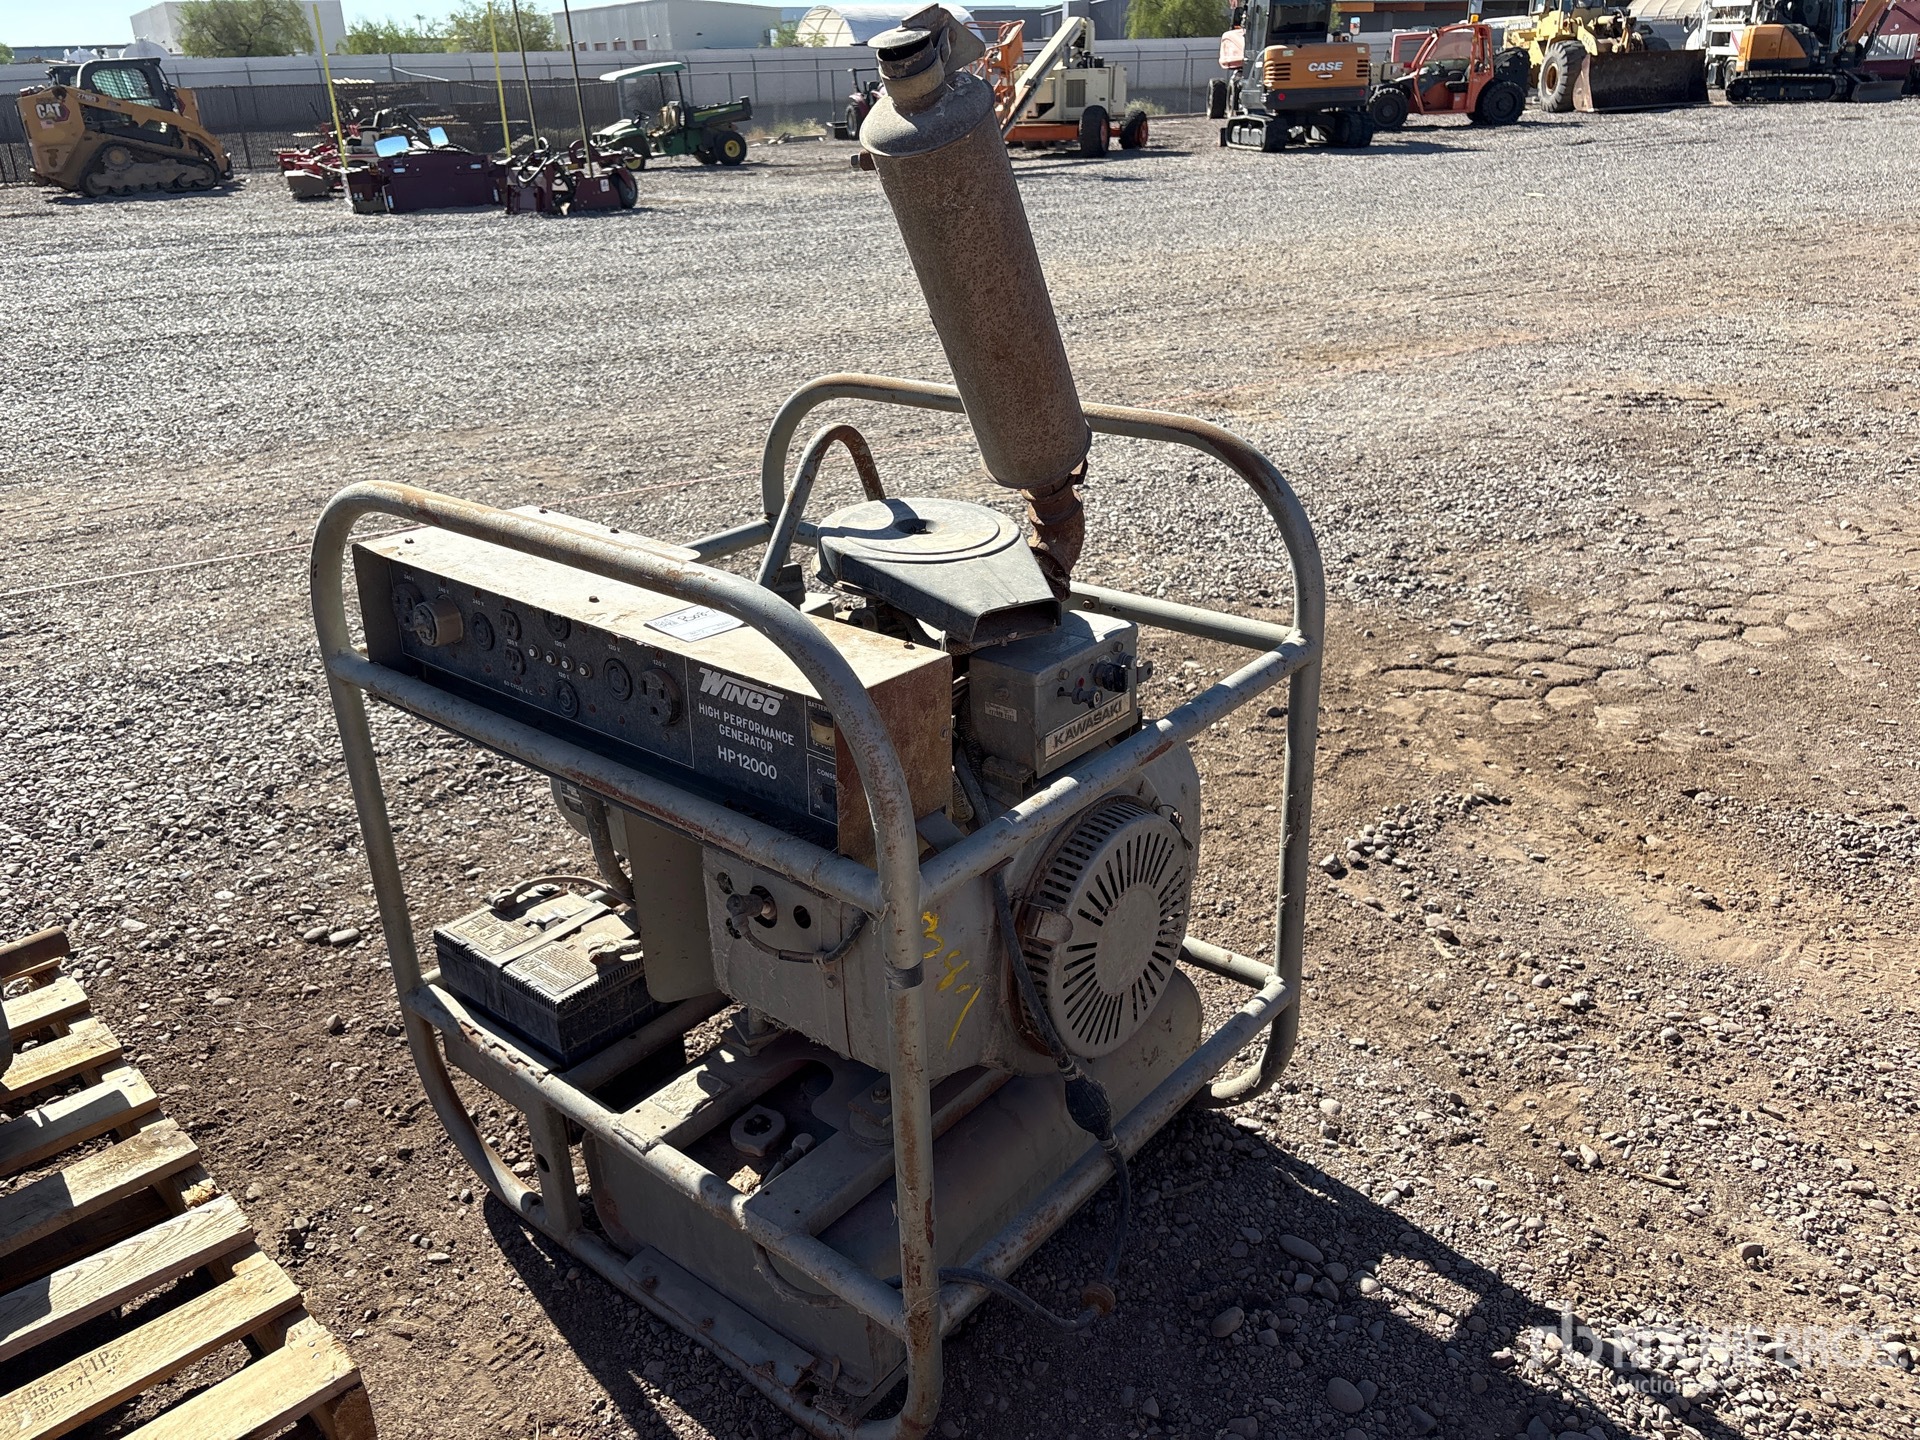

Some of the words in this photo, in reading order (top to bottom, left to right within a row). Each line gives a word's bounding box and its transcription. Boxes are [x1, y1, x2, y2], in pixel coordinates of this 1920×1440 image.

[1308, 61, 1344, 72] CASE
[36, 102, 62, 119] CAT
[653, 659, 662, 667] 120
[699, 667, 784, 716] WINCO
[698, 703, 720, 720] HIGH
[723, 711, 795, 746] PERFORMANCE
[718, 724, 774, 753] GENERATOR
[1053, 699, 1123, 748] KAWASAKI
[717, 745, 778, 780] HP12000
